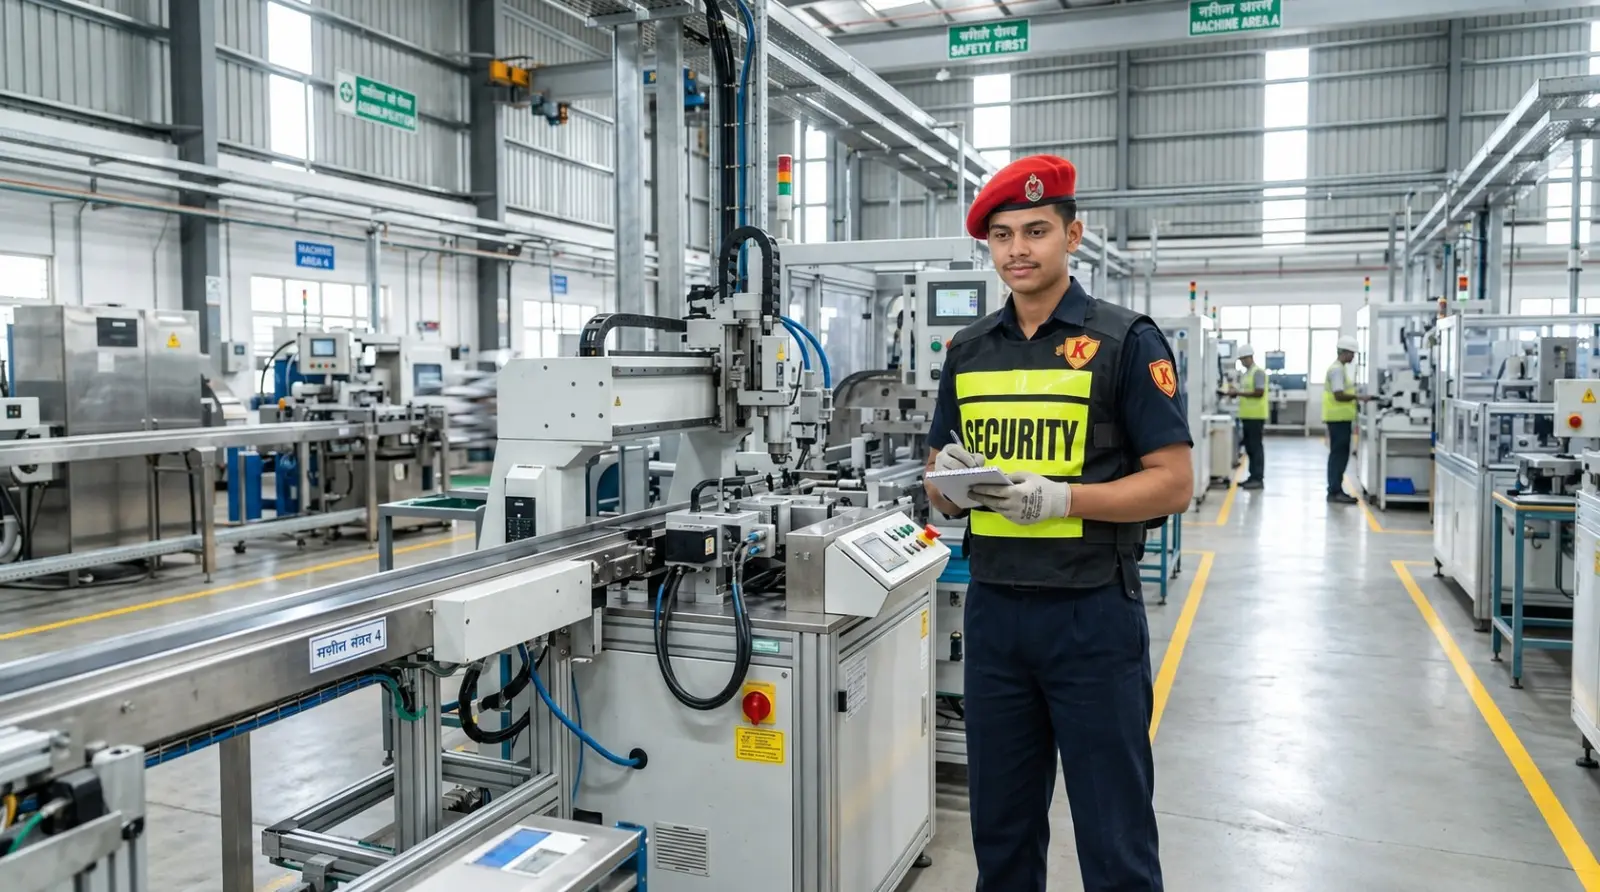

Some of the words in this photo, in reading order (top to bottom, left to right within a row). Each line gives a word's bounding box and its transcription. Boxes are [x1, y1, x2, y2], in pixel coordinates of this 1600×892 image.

[1192, 17, 1239, 33] MACHINE
[1241, 14, 1270, 28] AREA
[1271, 13, 1279, 26] A
[951, 41, 992, 57] SAFETY
[994, 38, 1026, 53] FIRST
[301, 255, 321, 267] AREA
[1070, 340, 1090, 360] K
[1160, 367, 1173, 386] K
[965, 418, 1079, 462] SECURITY
[375, 629, 381, 641] 4
